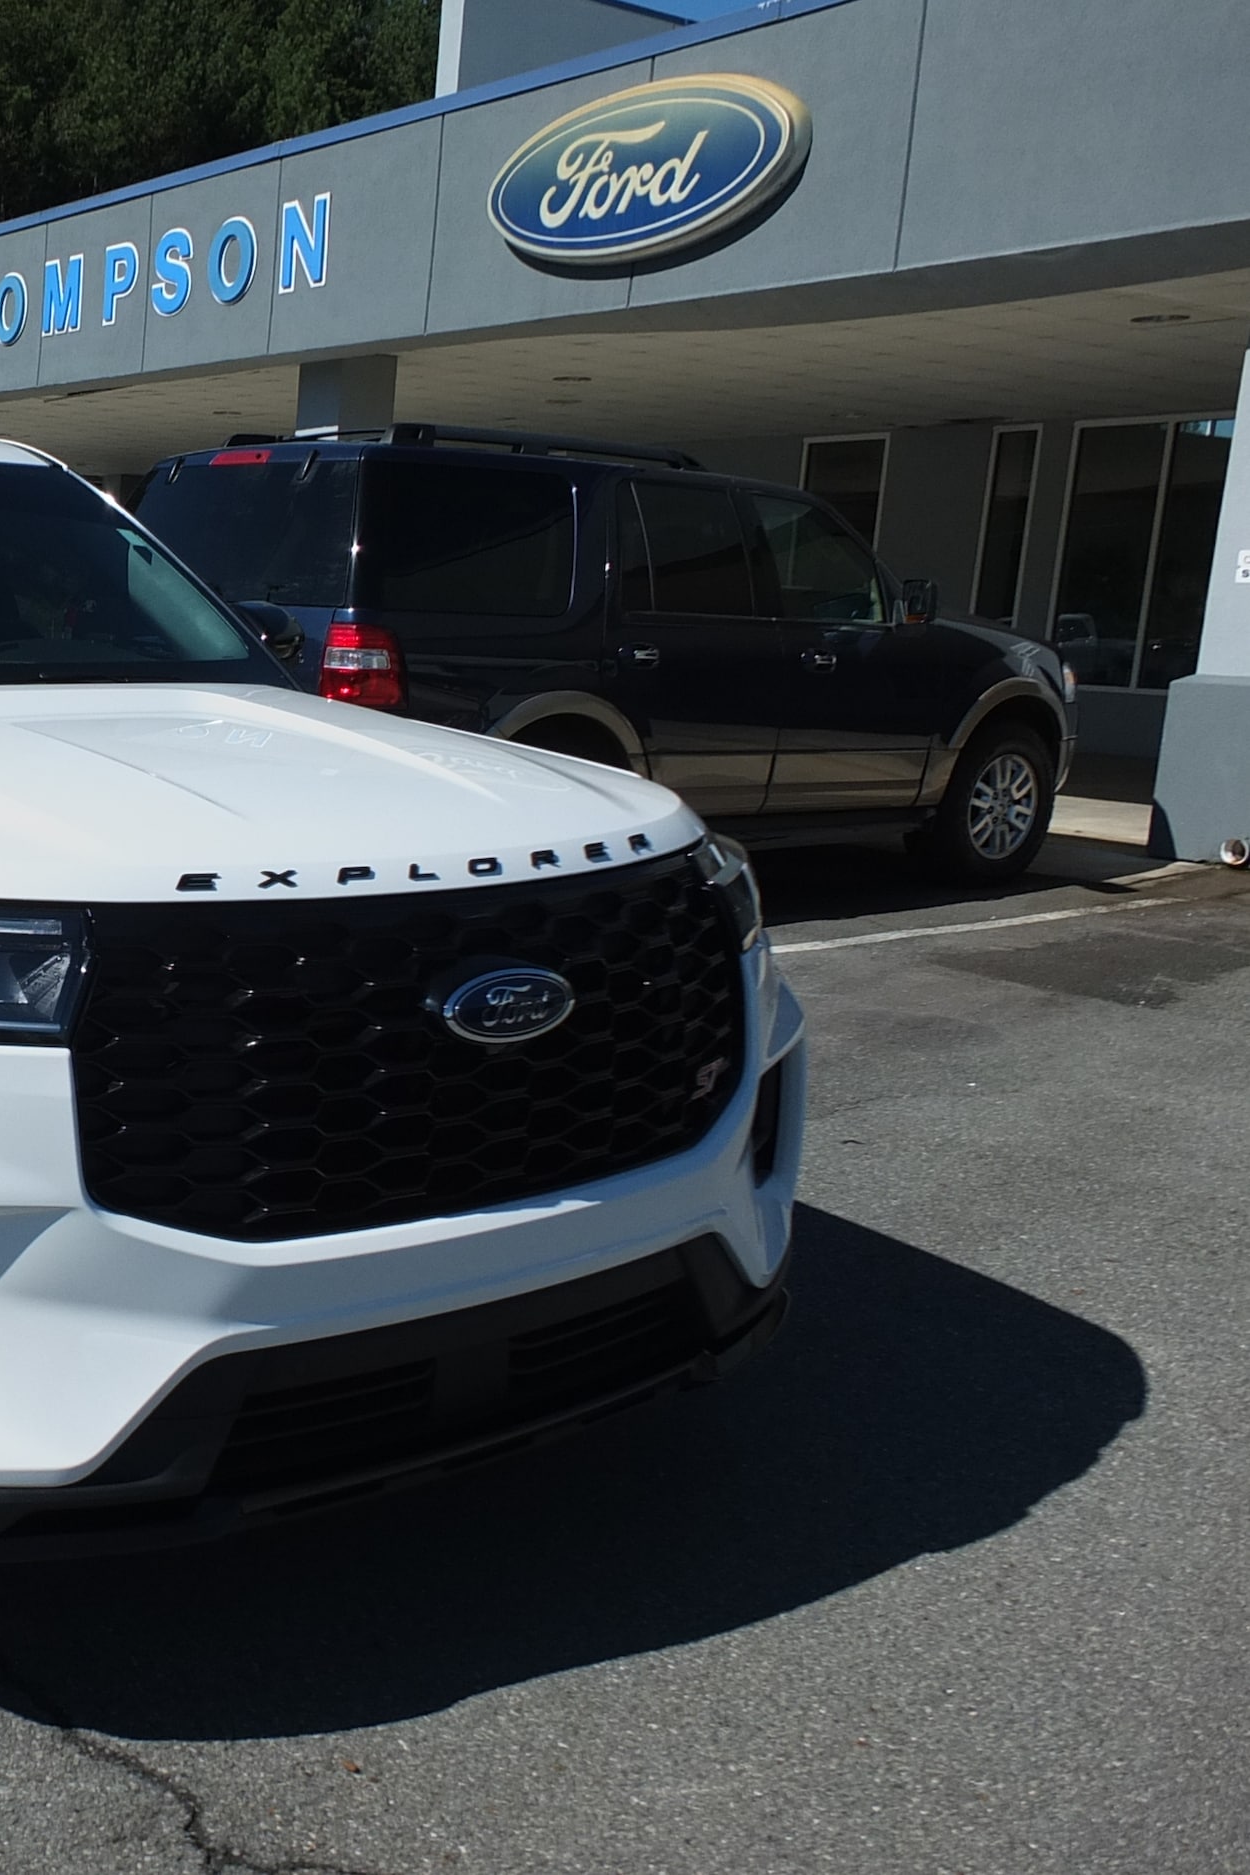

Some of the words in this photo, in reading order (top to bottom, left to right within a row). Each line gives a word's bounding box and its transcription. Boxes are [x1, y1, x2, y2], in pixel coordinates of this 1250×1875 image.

[539, 119, 709, 229] Ford
[175, 832, 654, 893] EXPLORER
[481, 984, 549, 1028] Ford
